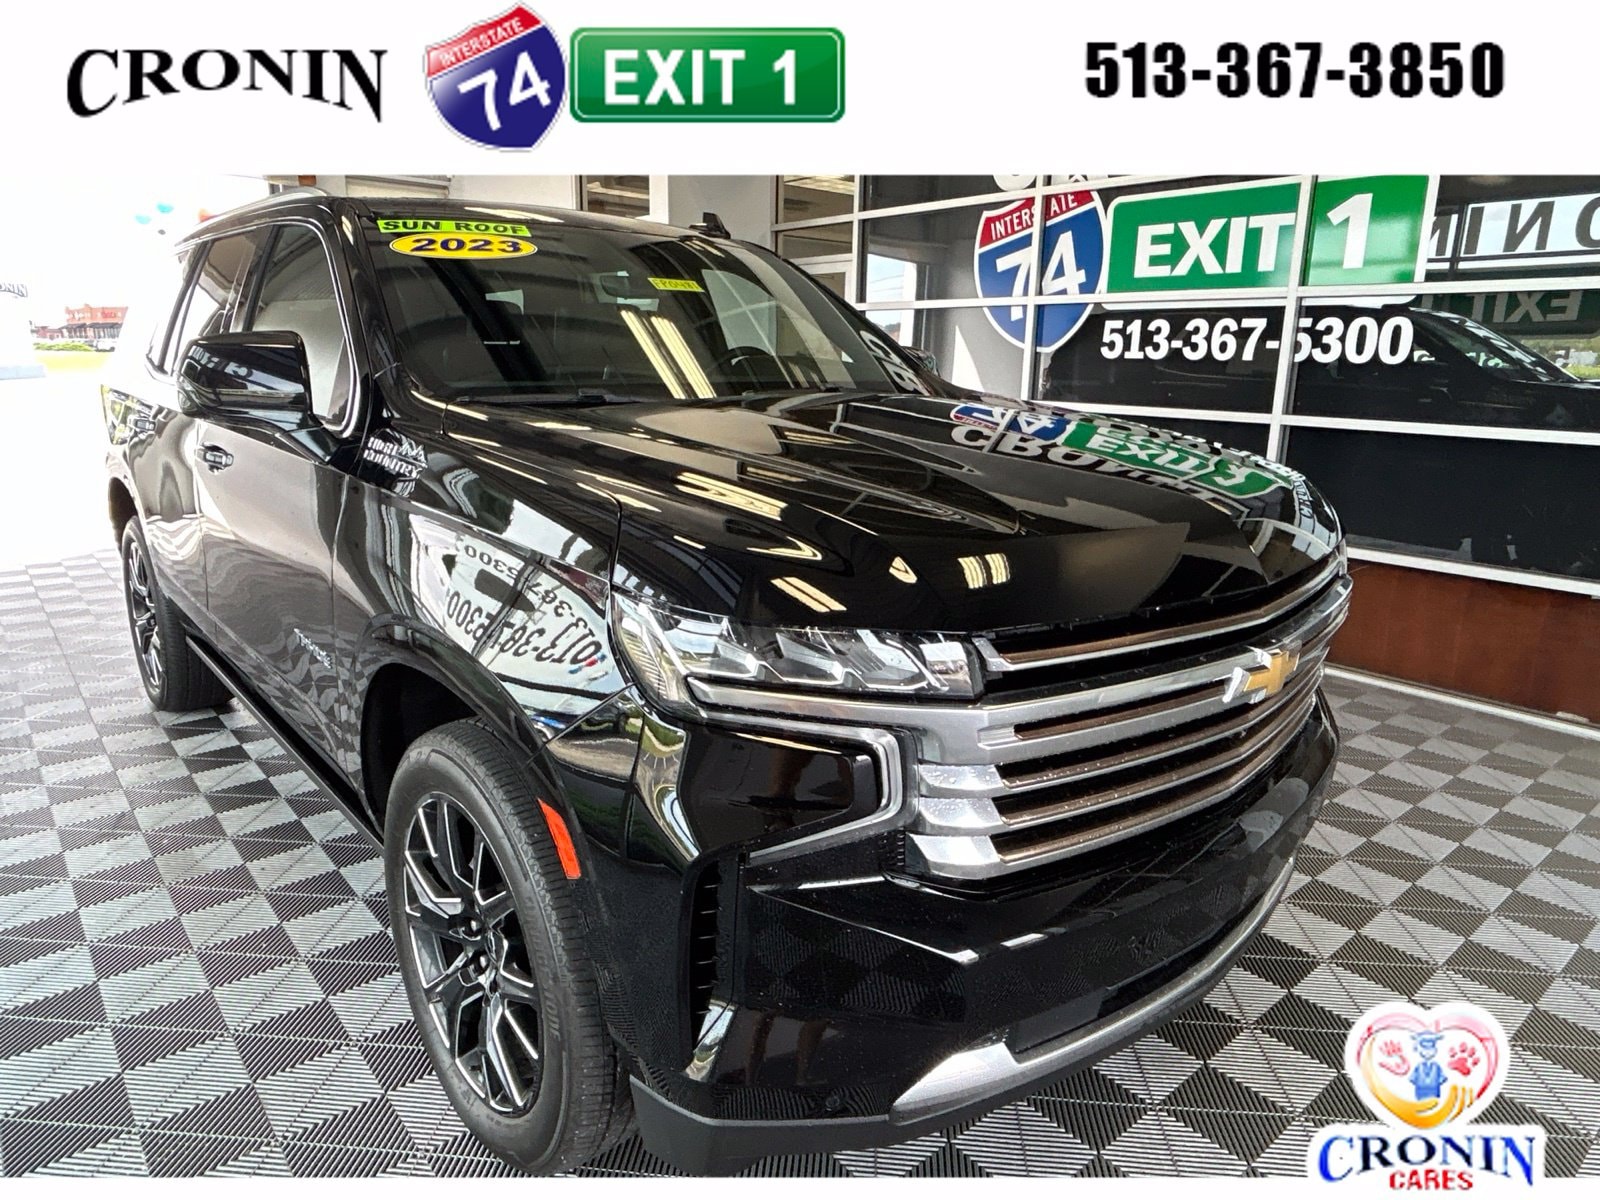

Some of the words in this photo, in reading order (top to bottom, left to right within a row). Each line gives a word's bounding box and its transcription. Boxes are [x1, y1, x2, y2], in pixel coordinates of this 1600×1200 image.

[382, 220, 442, 231] SUN
[454, 222, 525, 234] ROOF
[990, 193, 1078, 241] INTERSATE
[1132, 211, 1297, 280] EXIT
[1326, 192, 1374, 271] 1
[410, 237, 523, 254] 2023
[995, 230, 1086, 322] 74
[1100, 315, 1415, 366] 513-367-5300
